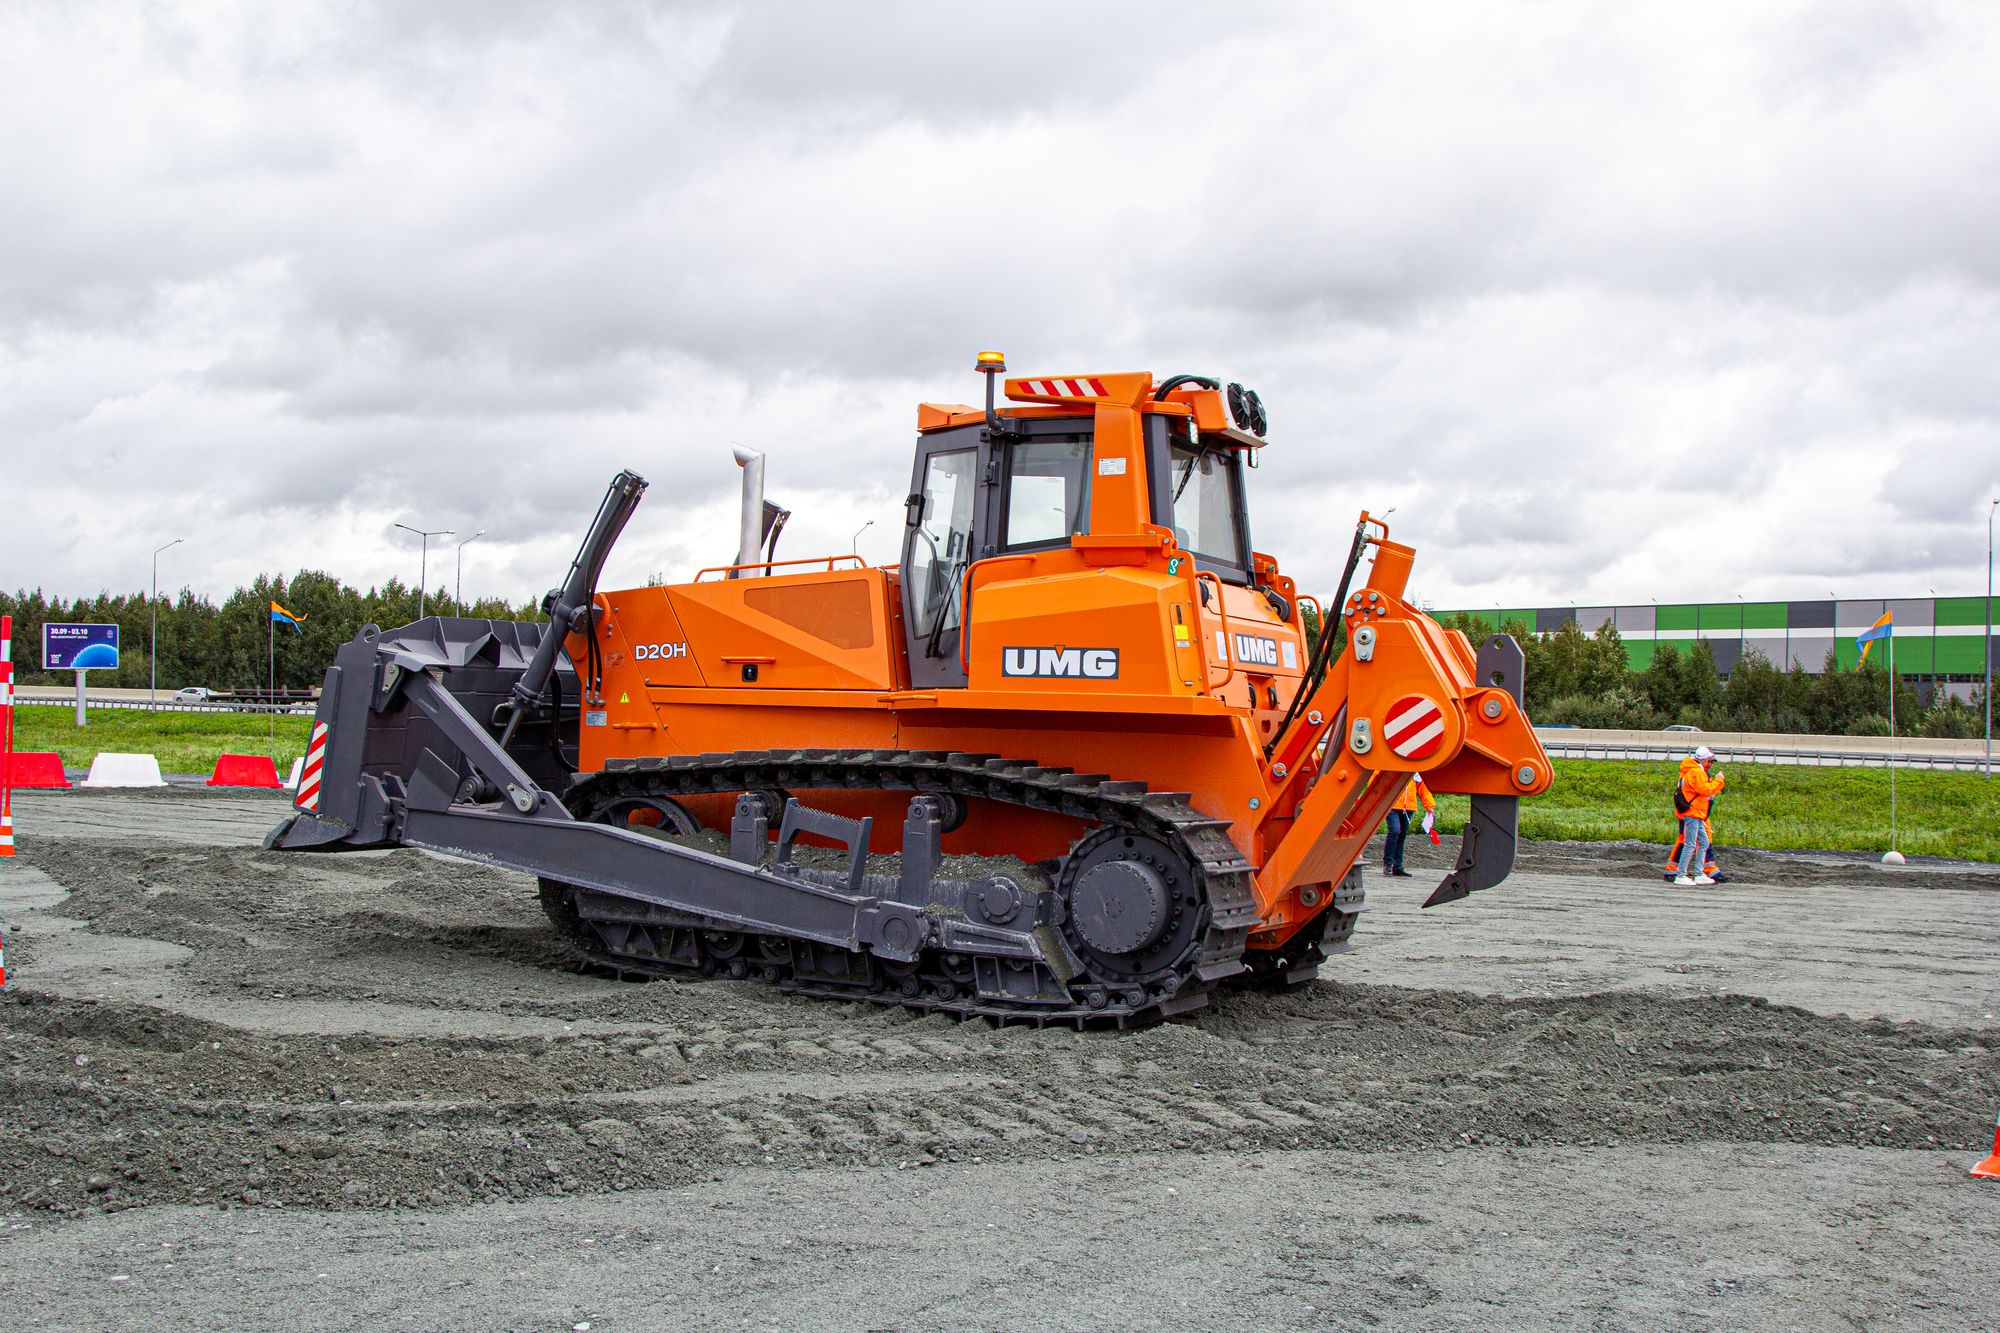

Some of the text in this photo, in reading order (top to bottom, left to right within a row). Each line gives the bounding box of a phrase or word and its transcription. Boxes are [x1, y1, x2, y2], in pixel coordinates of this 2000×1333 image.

[635, 642, 686, 660] D20H
[1005, 649, 1117, 677] UMG
[1236, 635, 1277, 665] UMG
